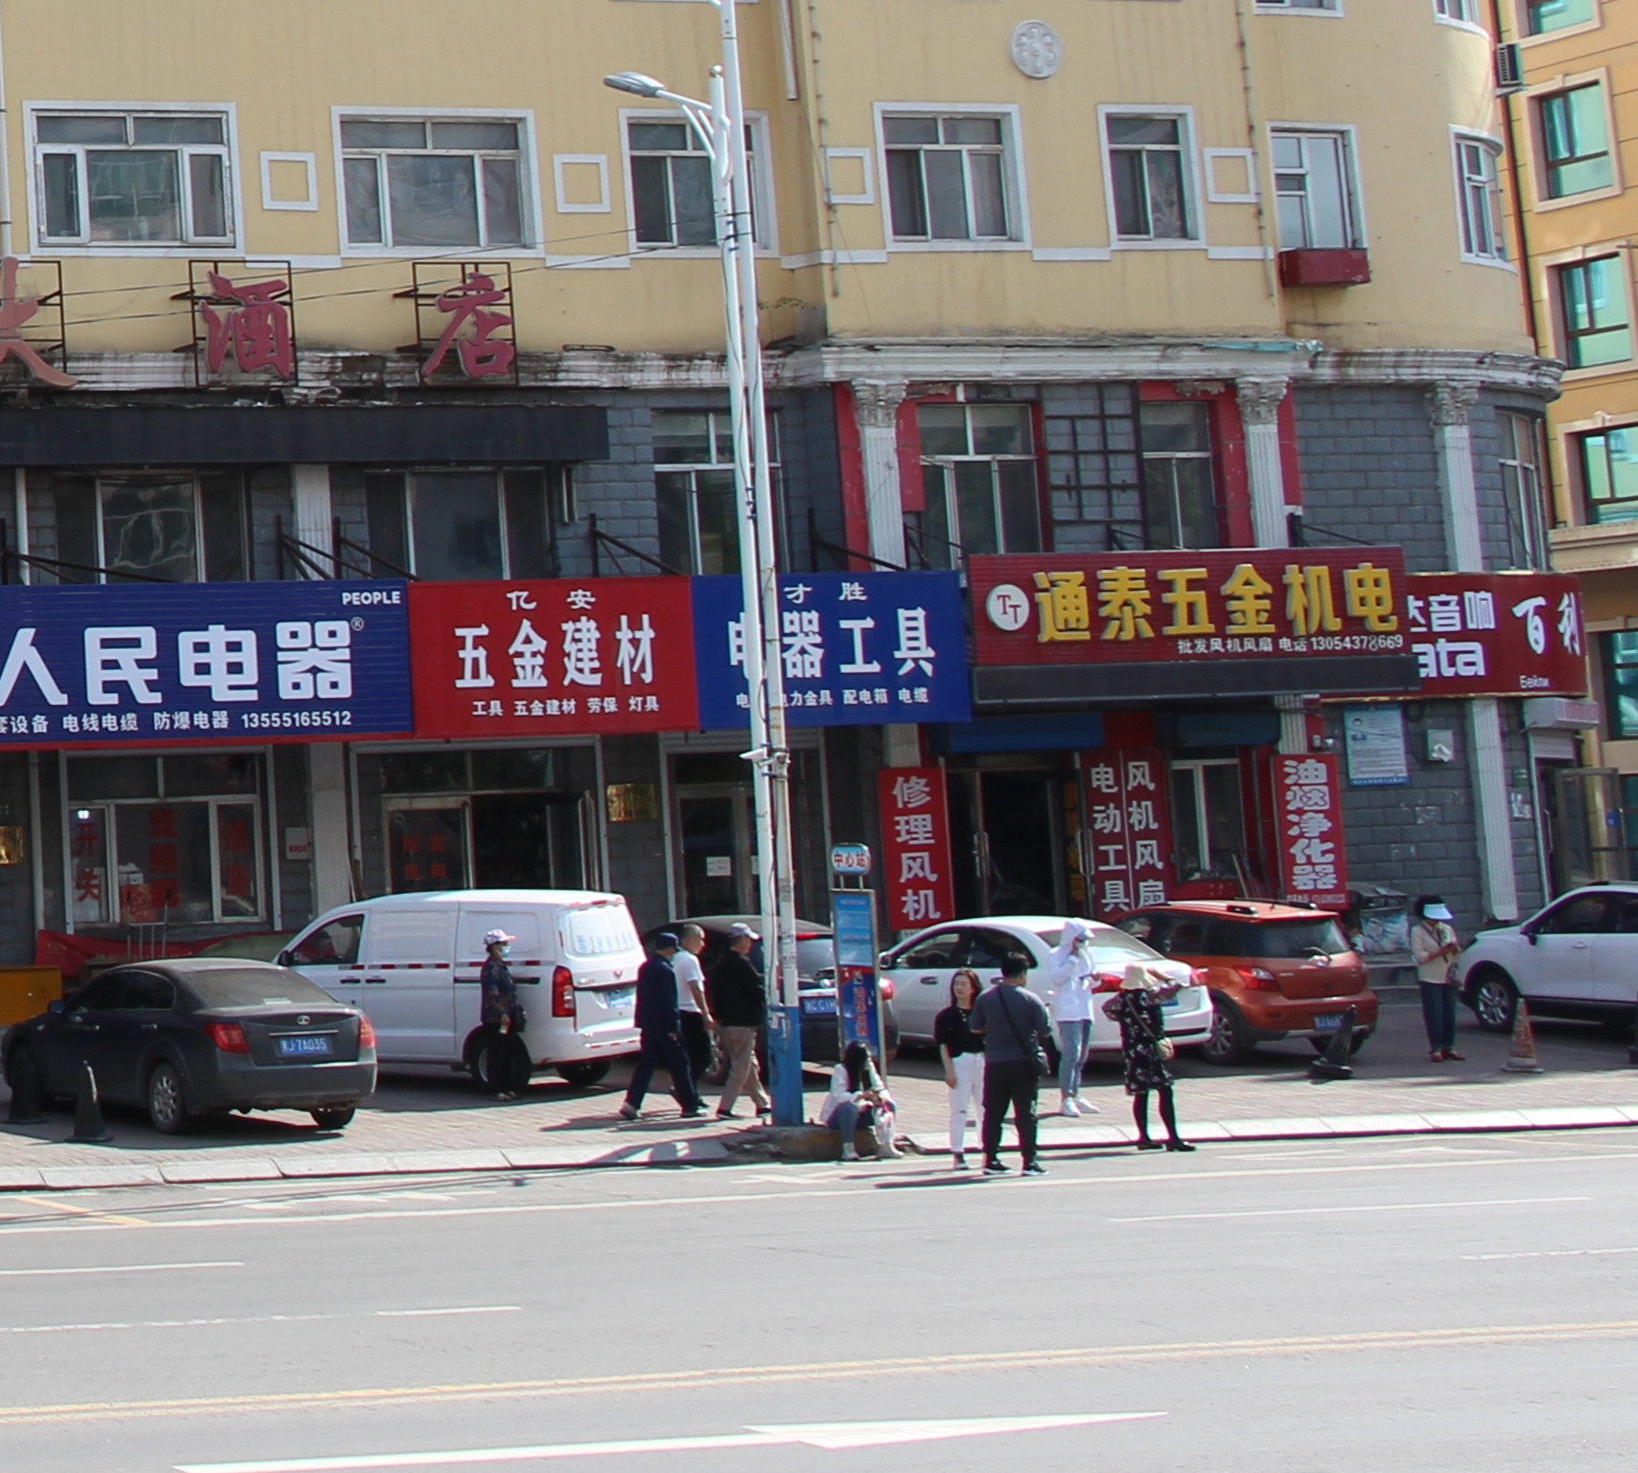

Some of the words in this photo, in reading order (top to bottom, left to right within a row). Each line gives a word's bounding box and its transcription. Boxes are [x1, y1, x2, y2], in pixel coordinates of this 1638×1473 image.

[342, 589, 401, 607] PEOPLE
[507, 589, 596, 610] 亿安
[1032, 562, 1398, 643] 通泰五金机电
[454, 613, 656, 689] 五金建材
[1177, 637, 1273, 654] 批发风机风扇
[1279, 636, 1308, 653] 电话
[472, 700, 504, 716] 工具
[514, 699, 577, 715] 五金建材
[587, 697, 619, 713] 劳保
[628, 696, 660, 712] 灯具
[842, 688, 888, 706] 配电箱
[898, 687, 929, 704] 电缆
[62, 713, 139, 733] 电线电缆
[153, 710, 231, 731] 防爆电器
[241, 710, 352, 729] 13555165512
[892, 775, 942, 922] 修理风机
[1090, 763, 1131, 913] 电动工具
[1127, 761, 1166, 909] 风机风扇
[1283, 758, 1338, 890] 油烟净化器
